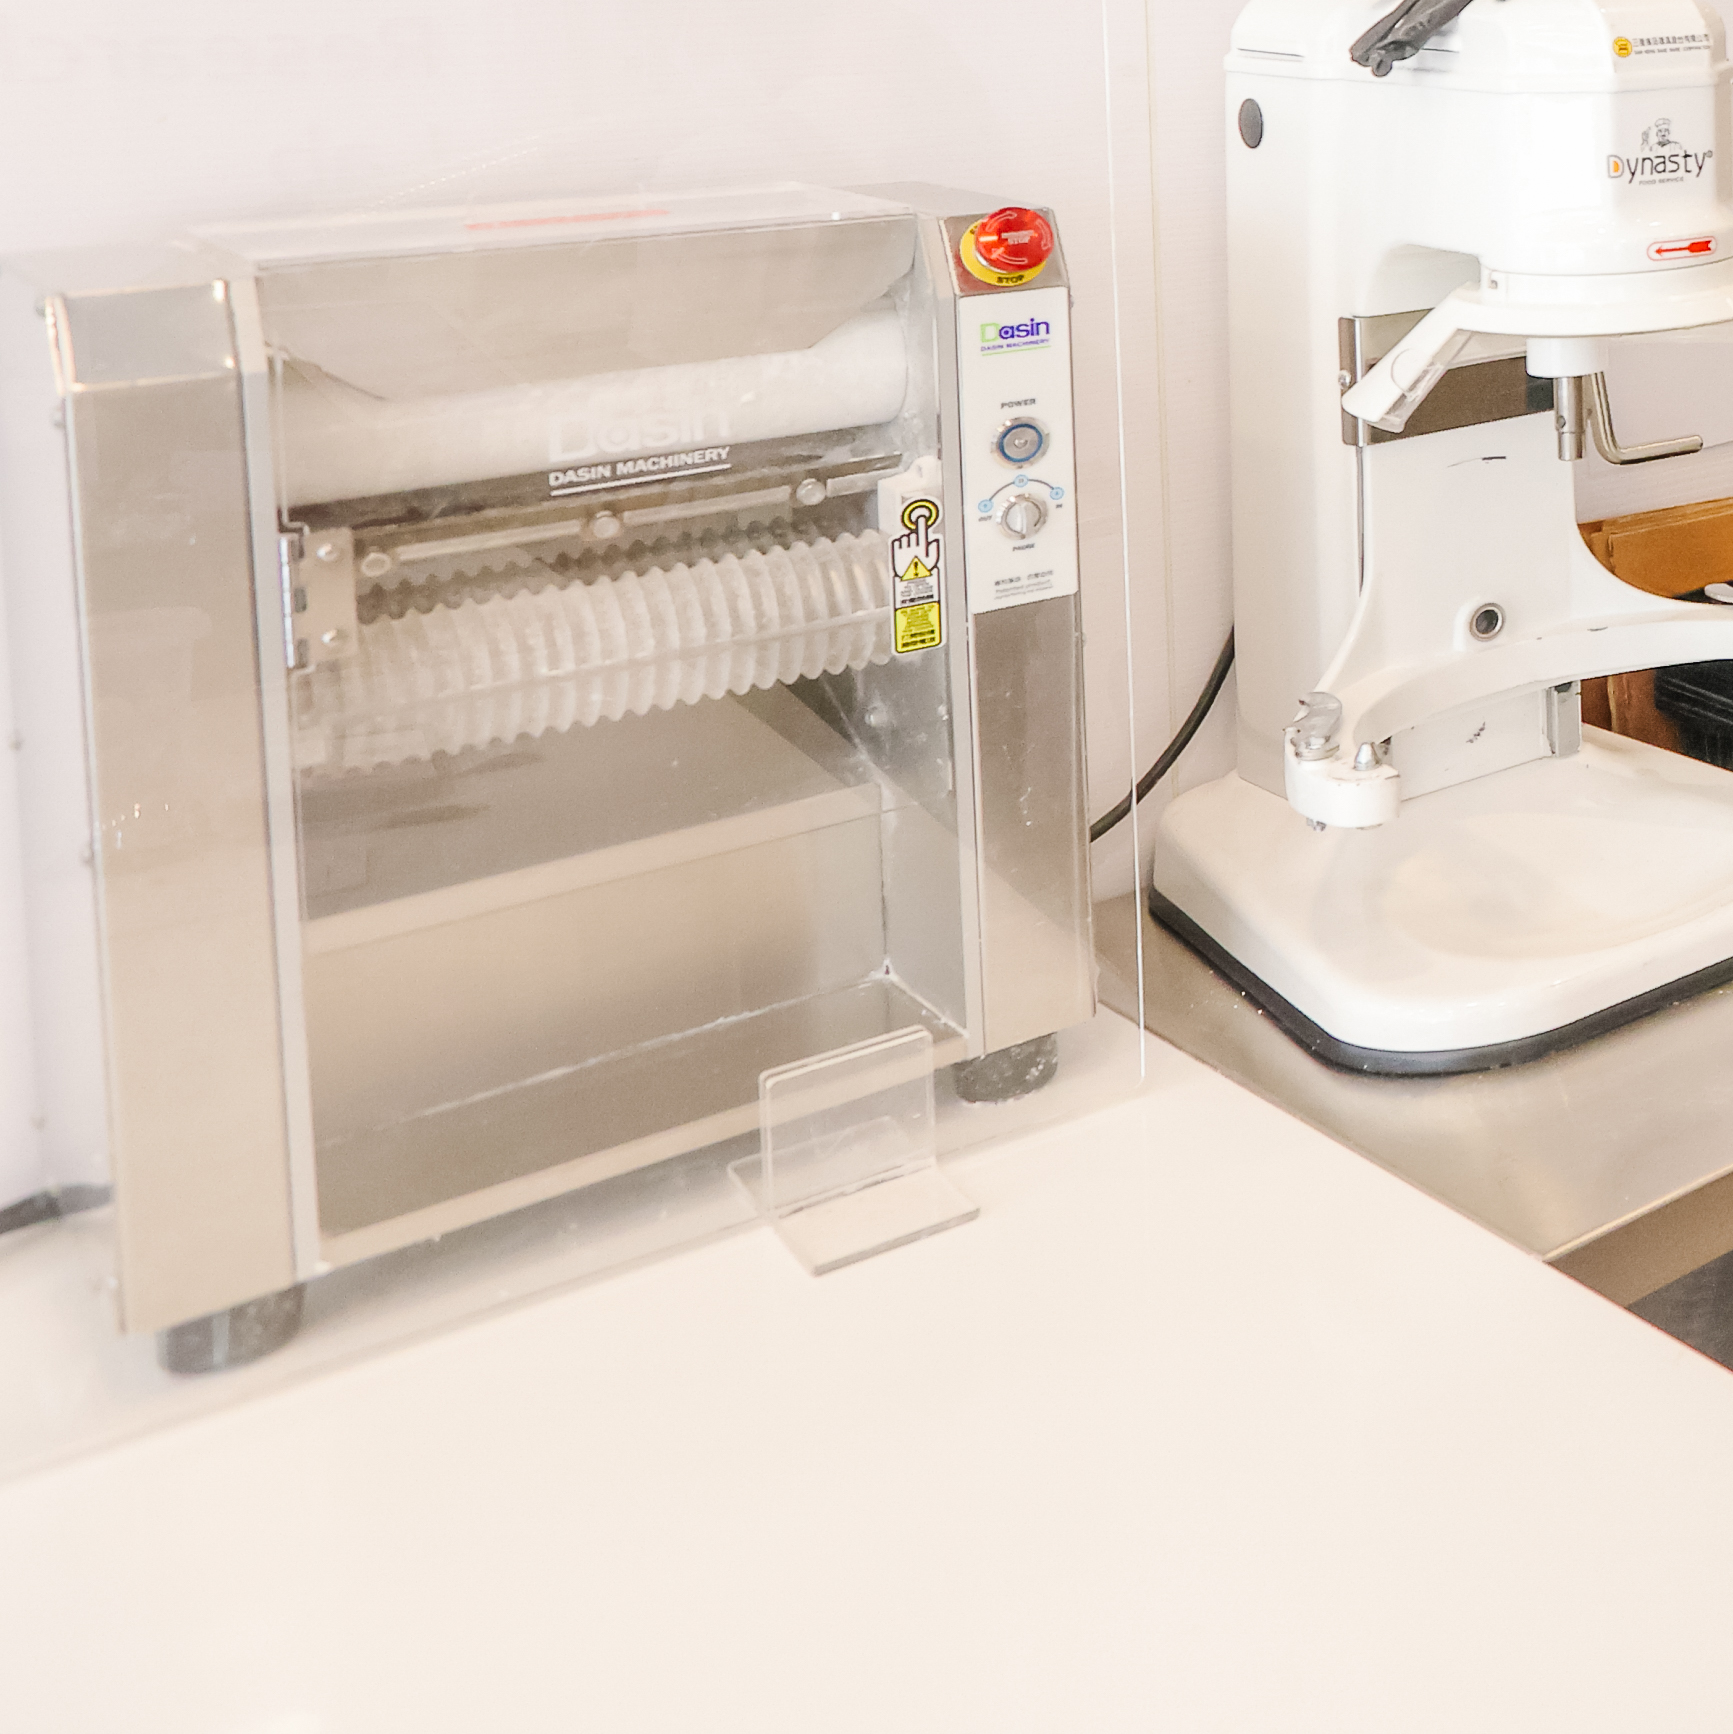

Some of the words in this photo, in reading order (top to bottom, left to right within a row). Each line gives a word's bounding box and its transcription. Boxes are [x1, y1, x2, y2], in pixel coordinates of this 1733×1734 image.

[1607, 150, 1708, 184] Dynasty
[996, 274, 1025, 284] STOP
[980, 318, 1050, 343] Dasin
[1000, 398, 1036, 410] POWER
[549, 465, 611, 487] DASIN
[616, 446, 731, 476] MACHINERY
